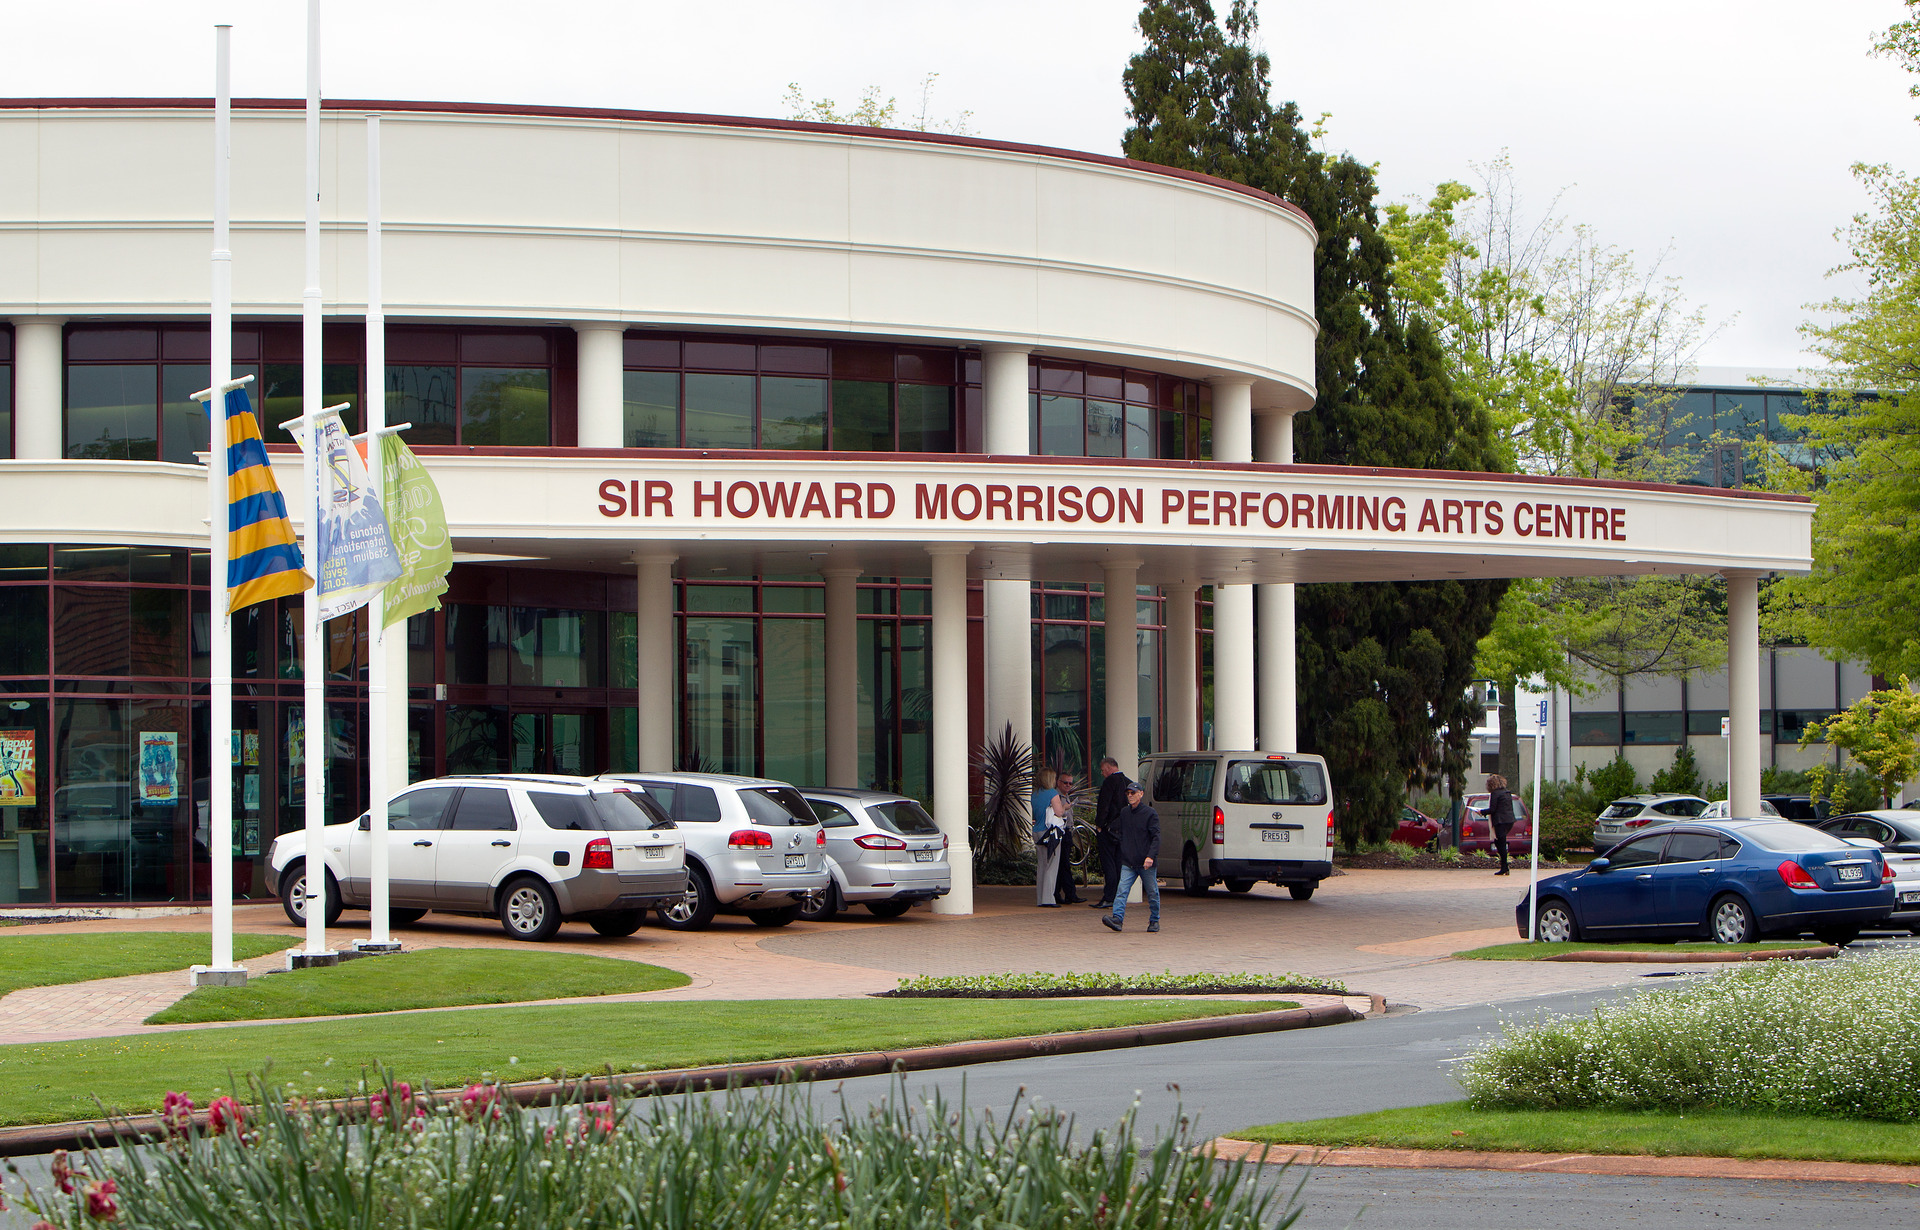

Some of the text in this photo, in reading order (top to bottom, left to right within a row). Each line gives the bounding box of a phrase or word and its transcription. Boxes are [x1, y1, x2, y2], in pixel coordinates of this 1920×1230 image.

[599, 480, 1625, 541] SIR HOWARD MORRISON PERFORMING ARTS CENTRE
[1263, 832, 1289, 840] FRE513
[1840, 867, 1862, 878] HJL939
